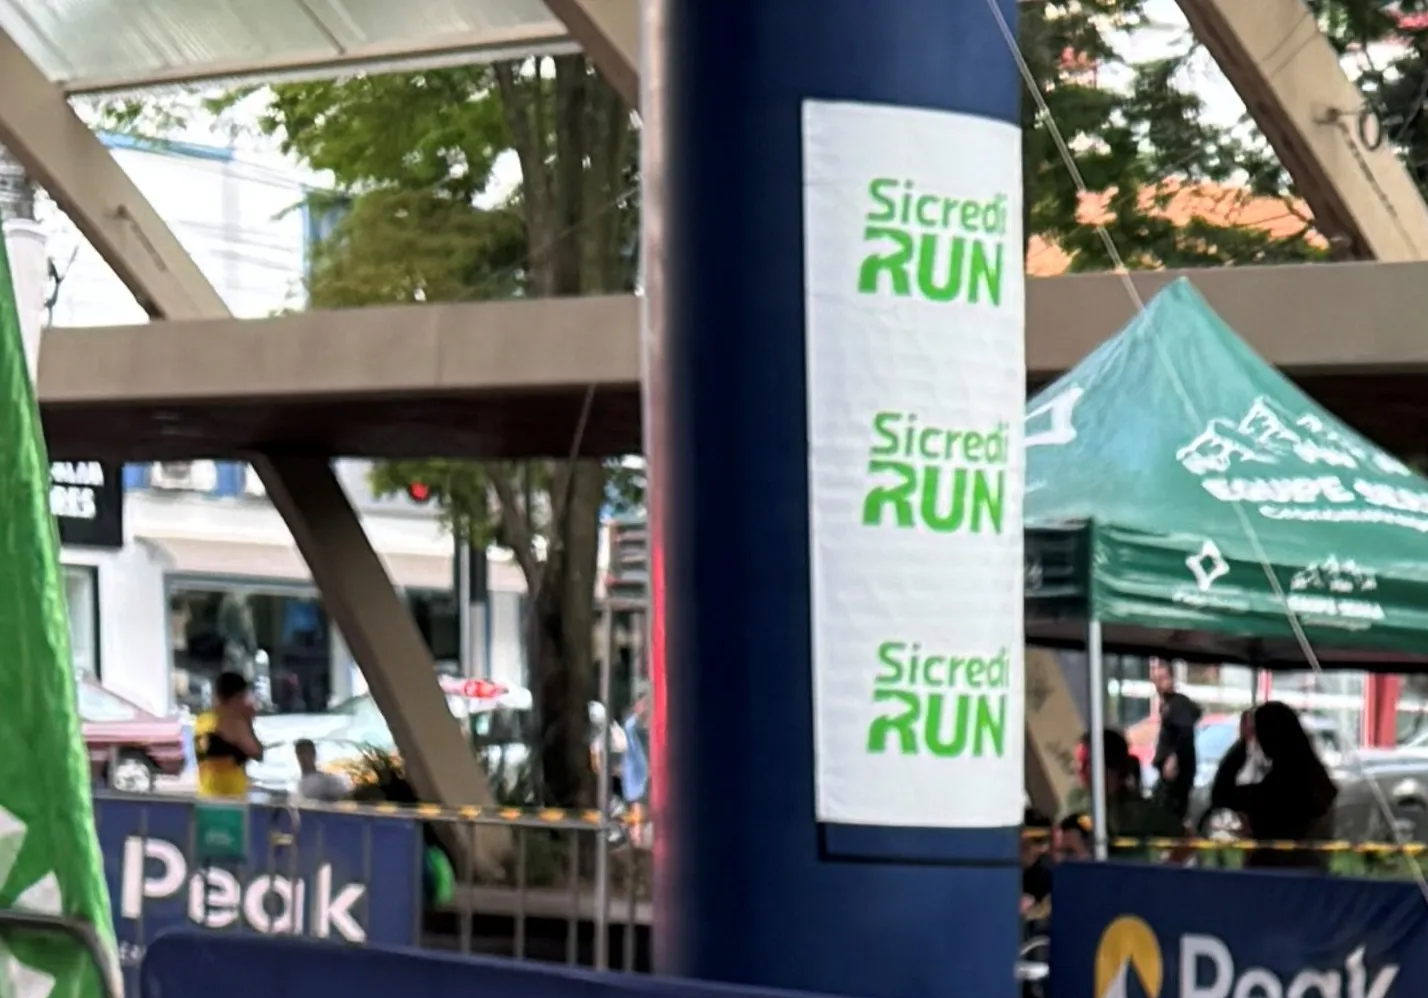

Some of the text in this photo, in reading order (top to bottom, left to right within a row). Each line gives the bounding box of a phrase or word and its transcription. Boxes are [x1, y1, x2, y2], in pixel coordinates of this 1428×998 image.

[866, 177, 1007, 235] Sicredi
[857, 226, 1003, 307] RUN
[870, 411, 1009, 463] Sicredi
[862, 459, 1004, 536] RUN
[875, 641, 1010, 689] Sicredi
[867, 689, 1006, 759] RUN
[120, 835, 367, 942] Peak
